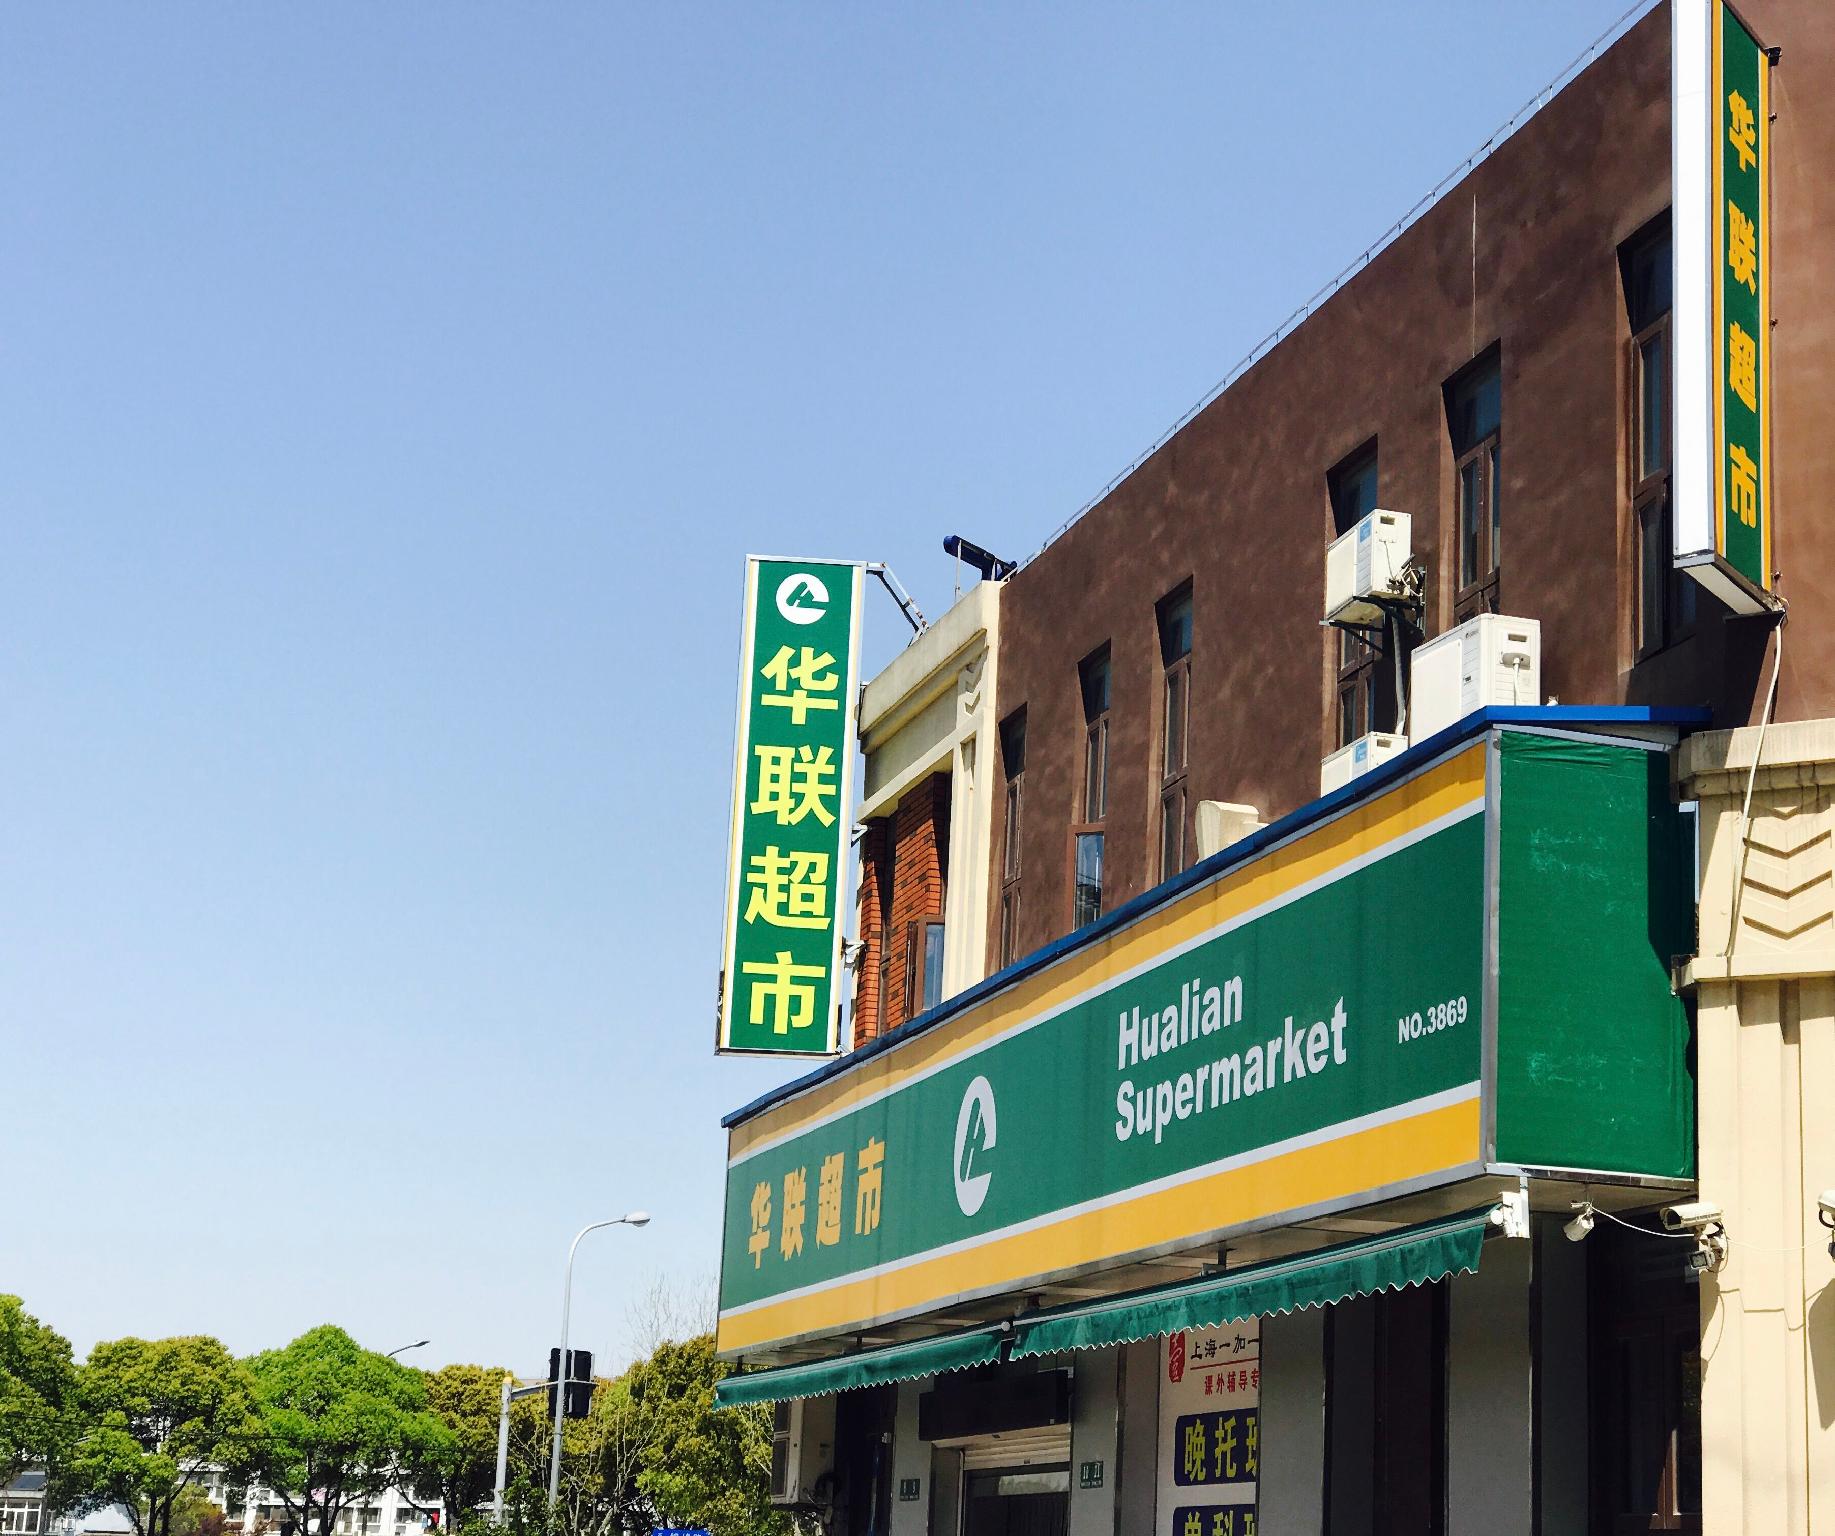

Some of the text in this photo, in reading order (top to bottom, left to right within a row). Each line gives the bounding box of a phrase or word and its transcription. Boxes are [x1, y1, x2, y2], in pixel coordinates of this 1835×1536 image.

[1728, 89, 1758, 529] 华联超市
[743, 645, 839, 1035] 华联超市
[1115, 996, 1348, 1144] Supermarket
[1117, 975, 1243, 1070] Hualian
[1398, 996, 1468, 1043] NO.3869
[748, 1135, 886, 1270] 华联超市
